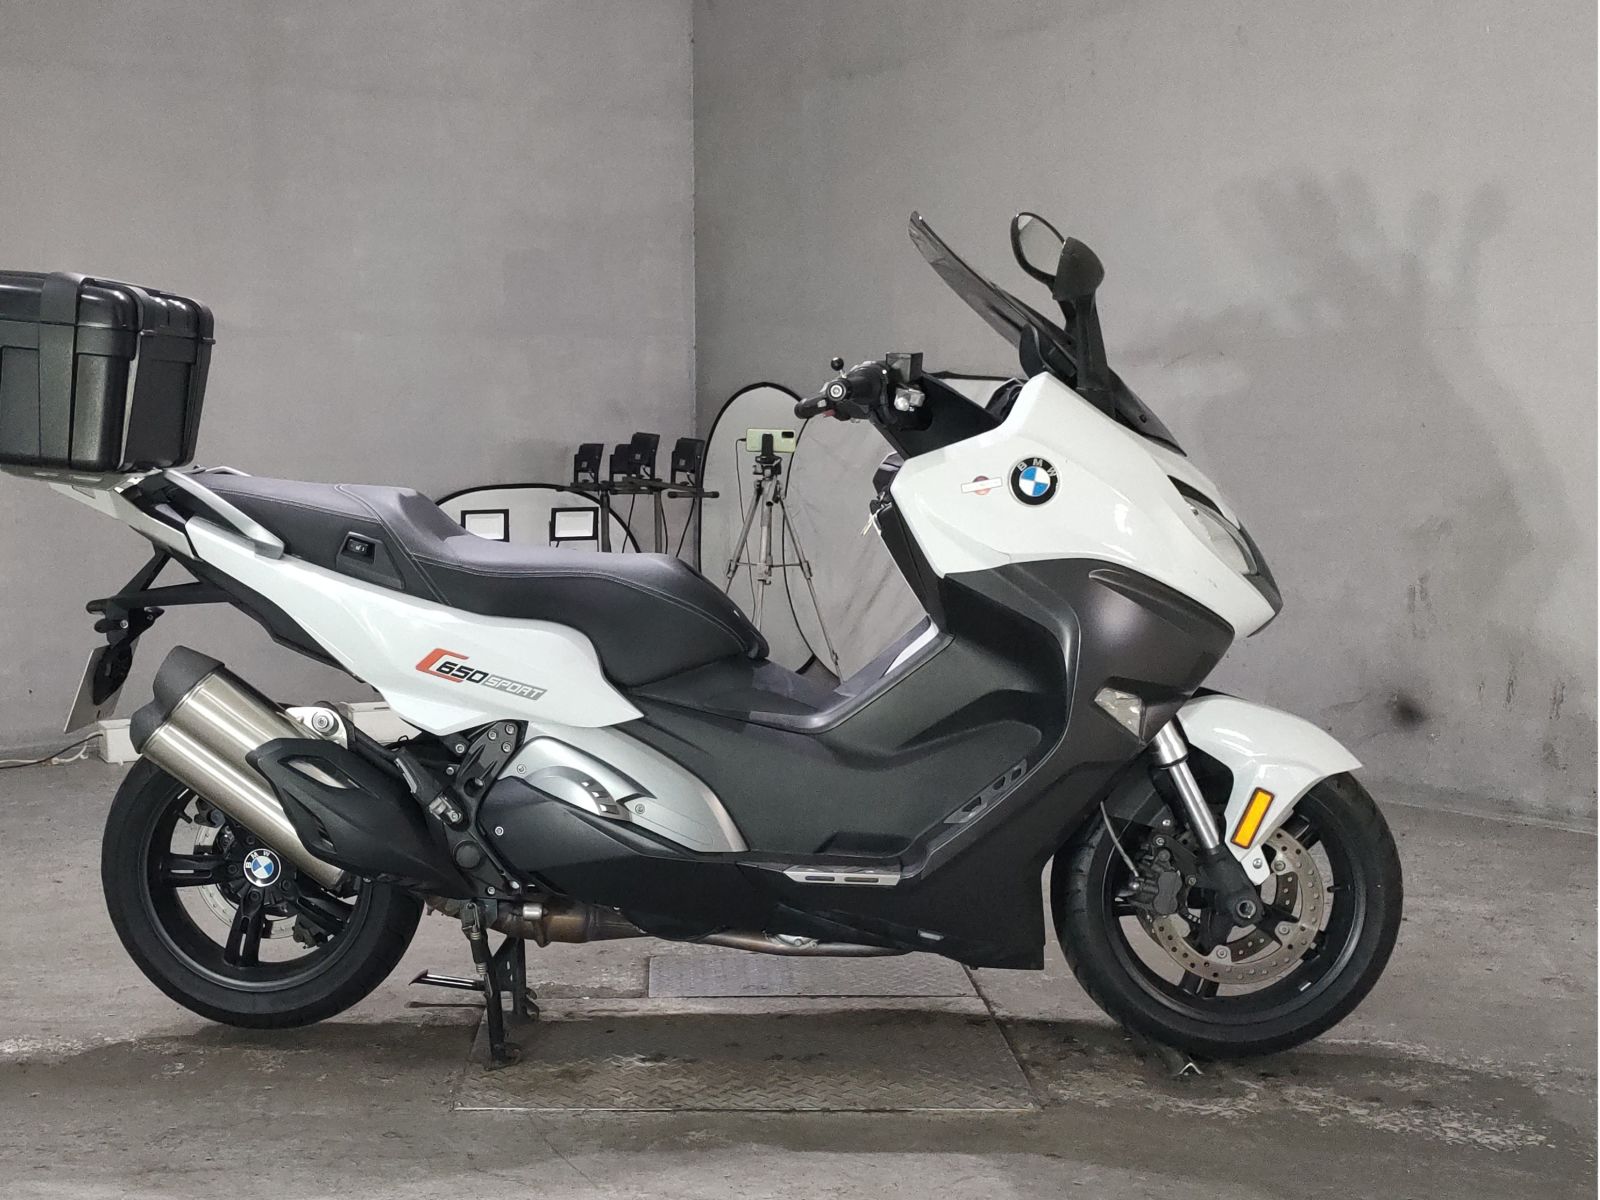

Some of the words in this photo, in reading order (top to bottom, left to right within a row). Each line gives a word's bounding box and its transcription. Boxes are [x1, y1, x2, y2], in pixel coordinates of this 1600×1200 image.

[1016, 458, 1057, 477] BMW
[483, 675, 546, 701] SPORT
[245, 850, 271, 869] BMW
